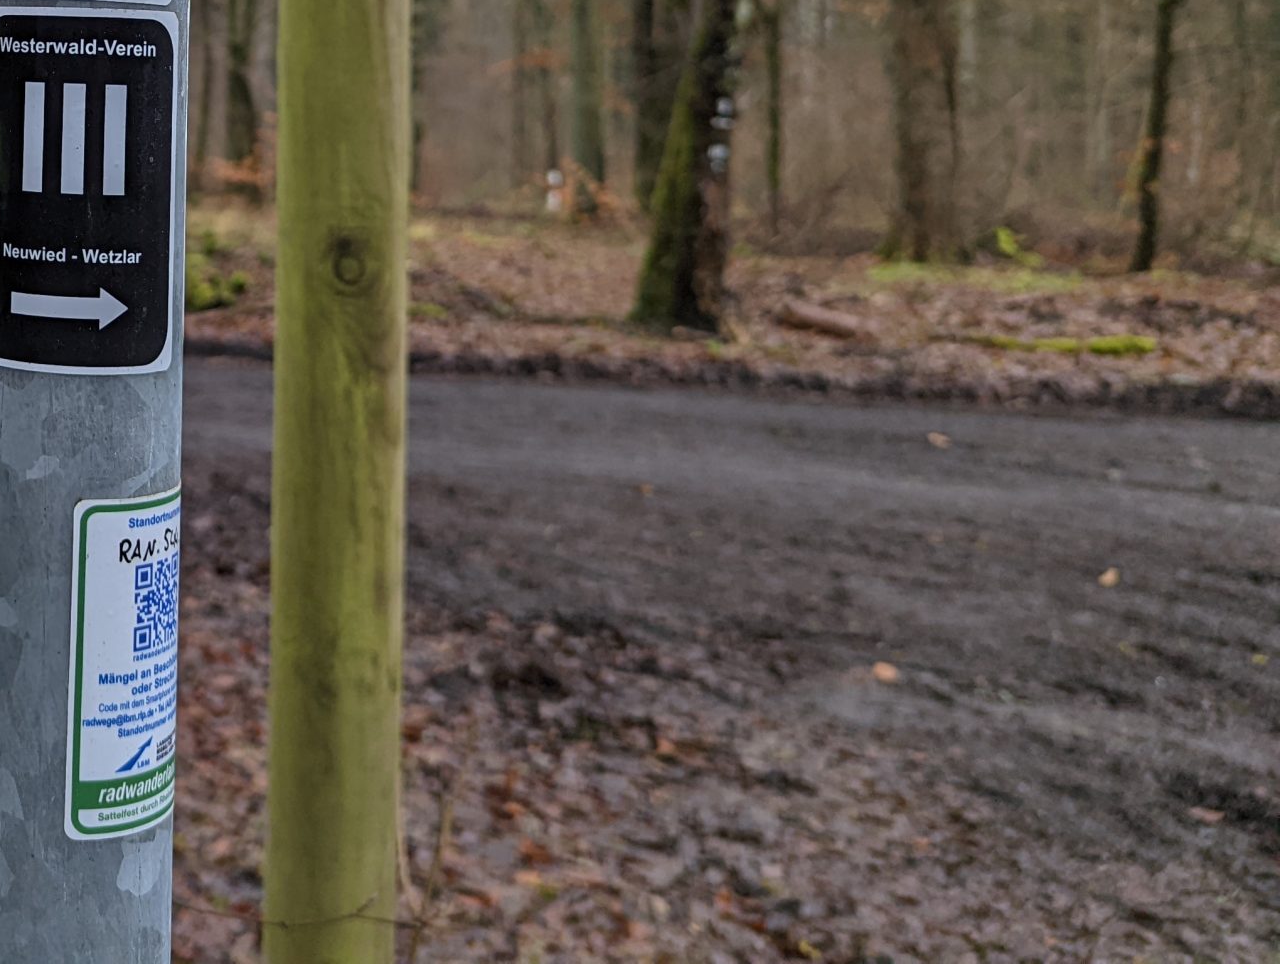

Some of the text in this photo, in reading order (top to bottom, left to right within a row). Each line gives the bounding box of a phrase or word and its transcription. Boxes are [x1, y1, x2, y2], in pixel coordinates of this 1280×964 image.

[0, 35, 157, 58] Westerwald-Verein
[2, 242, 67, 263] Neuwied
[82, 247, 142, 265] Wetzlar
[98, 667, 138, 685] Mängel
[140, 668, 151, 679] an
[131, 682, 152, 696] oder
[98, 703, 118, 713] Code
[119, 700, 130, 711] mit
[98, 806, 139, 822] Sattelfest
